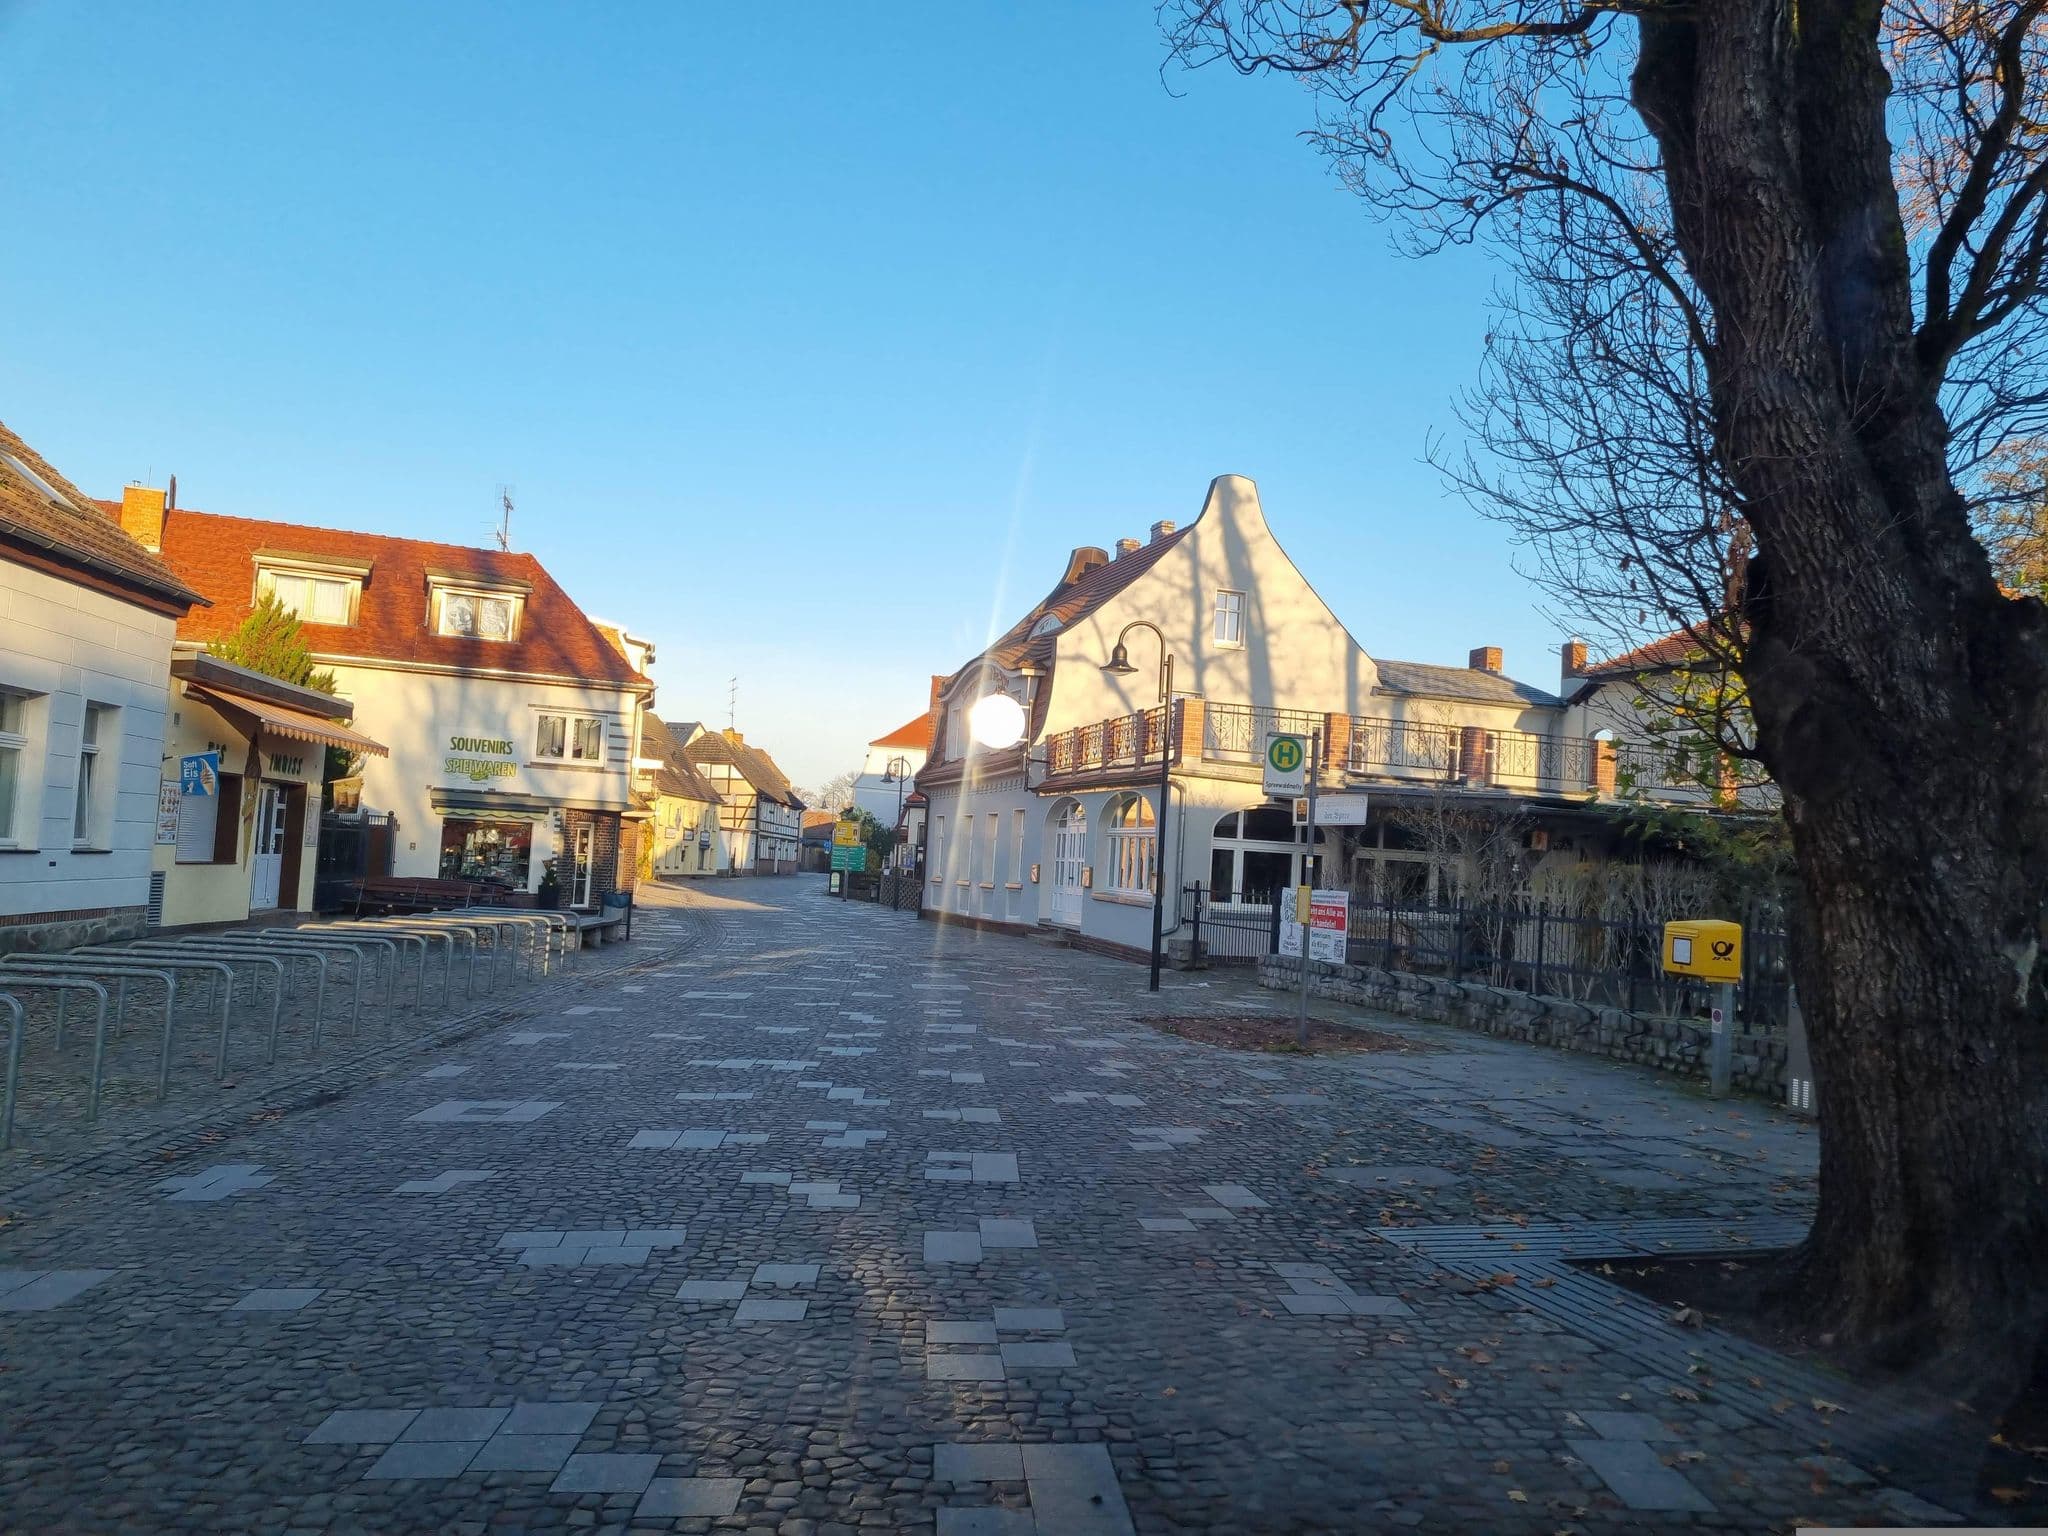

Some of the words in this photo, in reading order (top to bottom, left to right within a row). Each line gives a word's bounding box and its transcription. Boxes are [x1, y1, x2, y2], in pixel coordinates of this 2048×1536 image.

[450, 736, 513, 755] SOUVENIRS
[1277, 745, 1294, 764] H
[183, 760, 197, 769] Soft
[183, 768, 199, 778] Eis
[269, 753, 303, 775] IMBISS
[445, 758, 517, 777] SPIELWAREN
